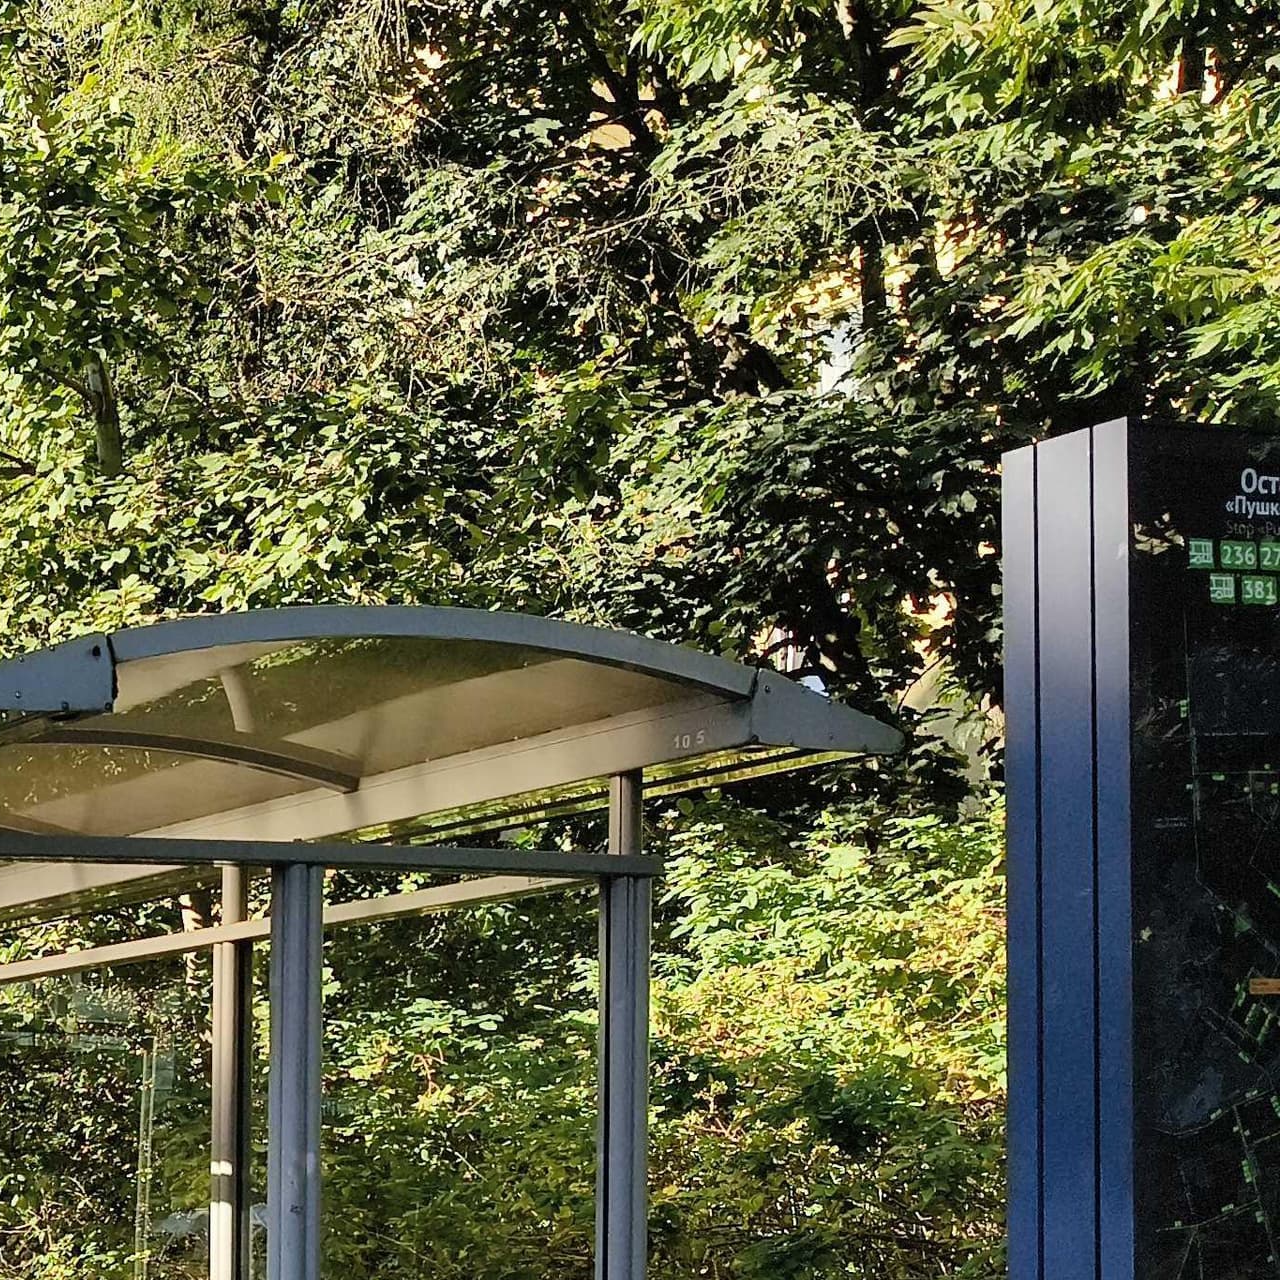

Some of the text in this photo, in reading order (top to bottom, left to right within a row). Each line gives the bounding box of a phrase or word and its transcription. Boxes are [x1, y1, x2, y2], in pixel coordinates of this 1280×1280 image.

[1241, 468, 1280, 495] Ост
[1225, 495, 1280, 519] «Пушк
[1223, 546, 1255, 565] 236
[1243, 580, 1276, 600] 381
